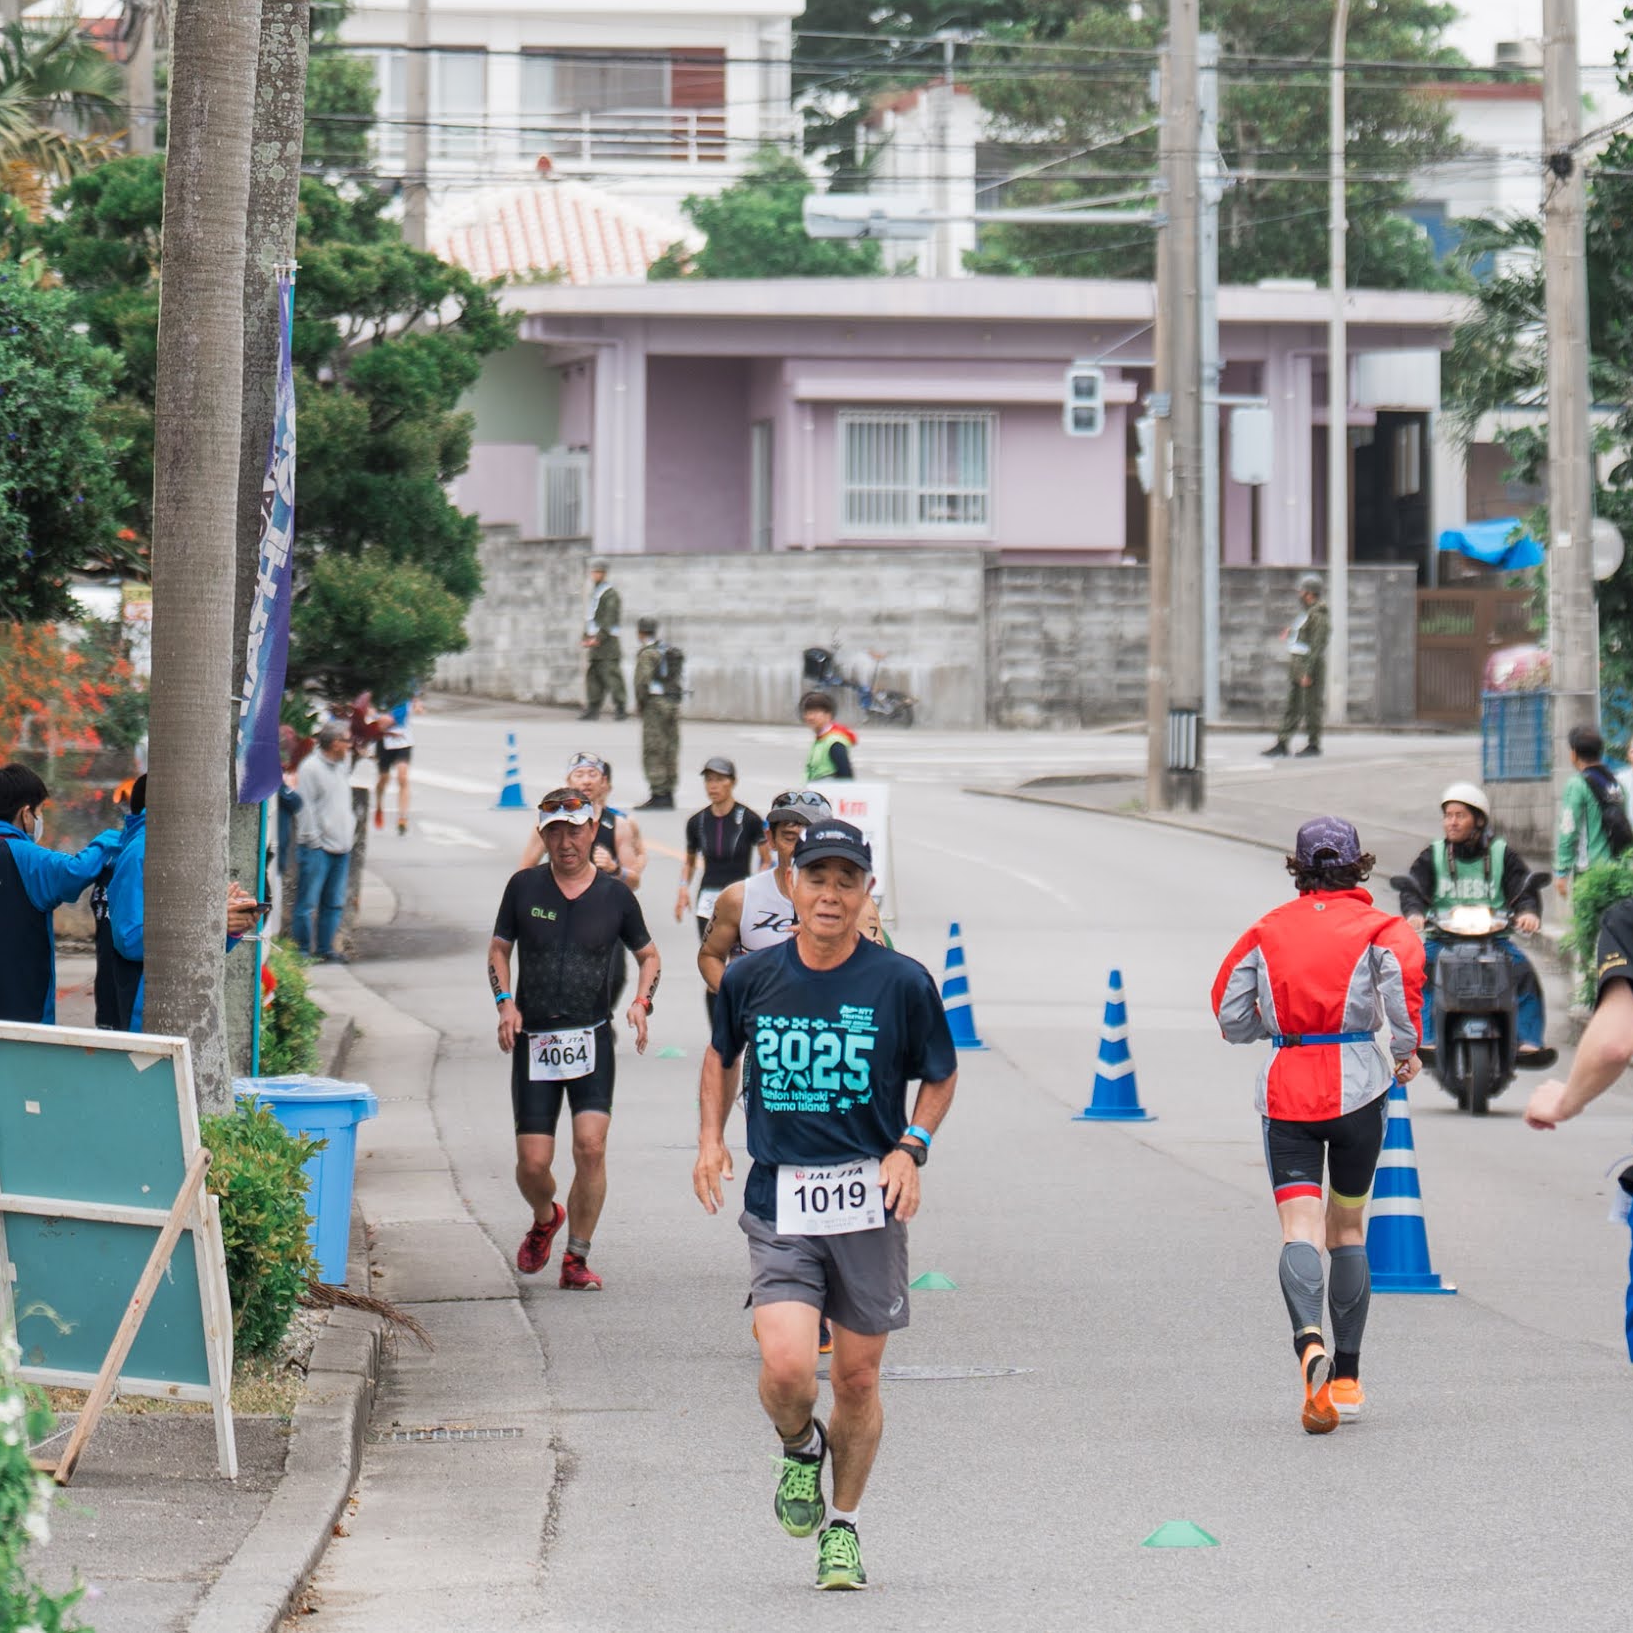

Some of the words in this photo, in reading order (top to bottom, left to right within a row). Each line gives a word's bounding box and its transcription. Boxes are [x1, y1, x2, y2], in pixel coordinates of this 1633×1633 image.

[567, 1036, 584, 1044] JTA
[538, 1045, 588, 1066] 4064
[756, 1029, 875, 1092] 2025
[792, 1090, 829, 1103] Ishigaki
[798, 1101, 831, 1113] Islands
[808, 1172, 833, 1181] JAL
[837, 1167, 864, 1178] JTA
[794, 1181, 867, 1214] 1019
